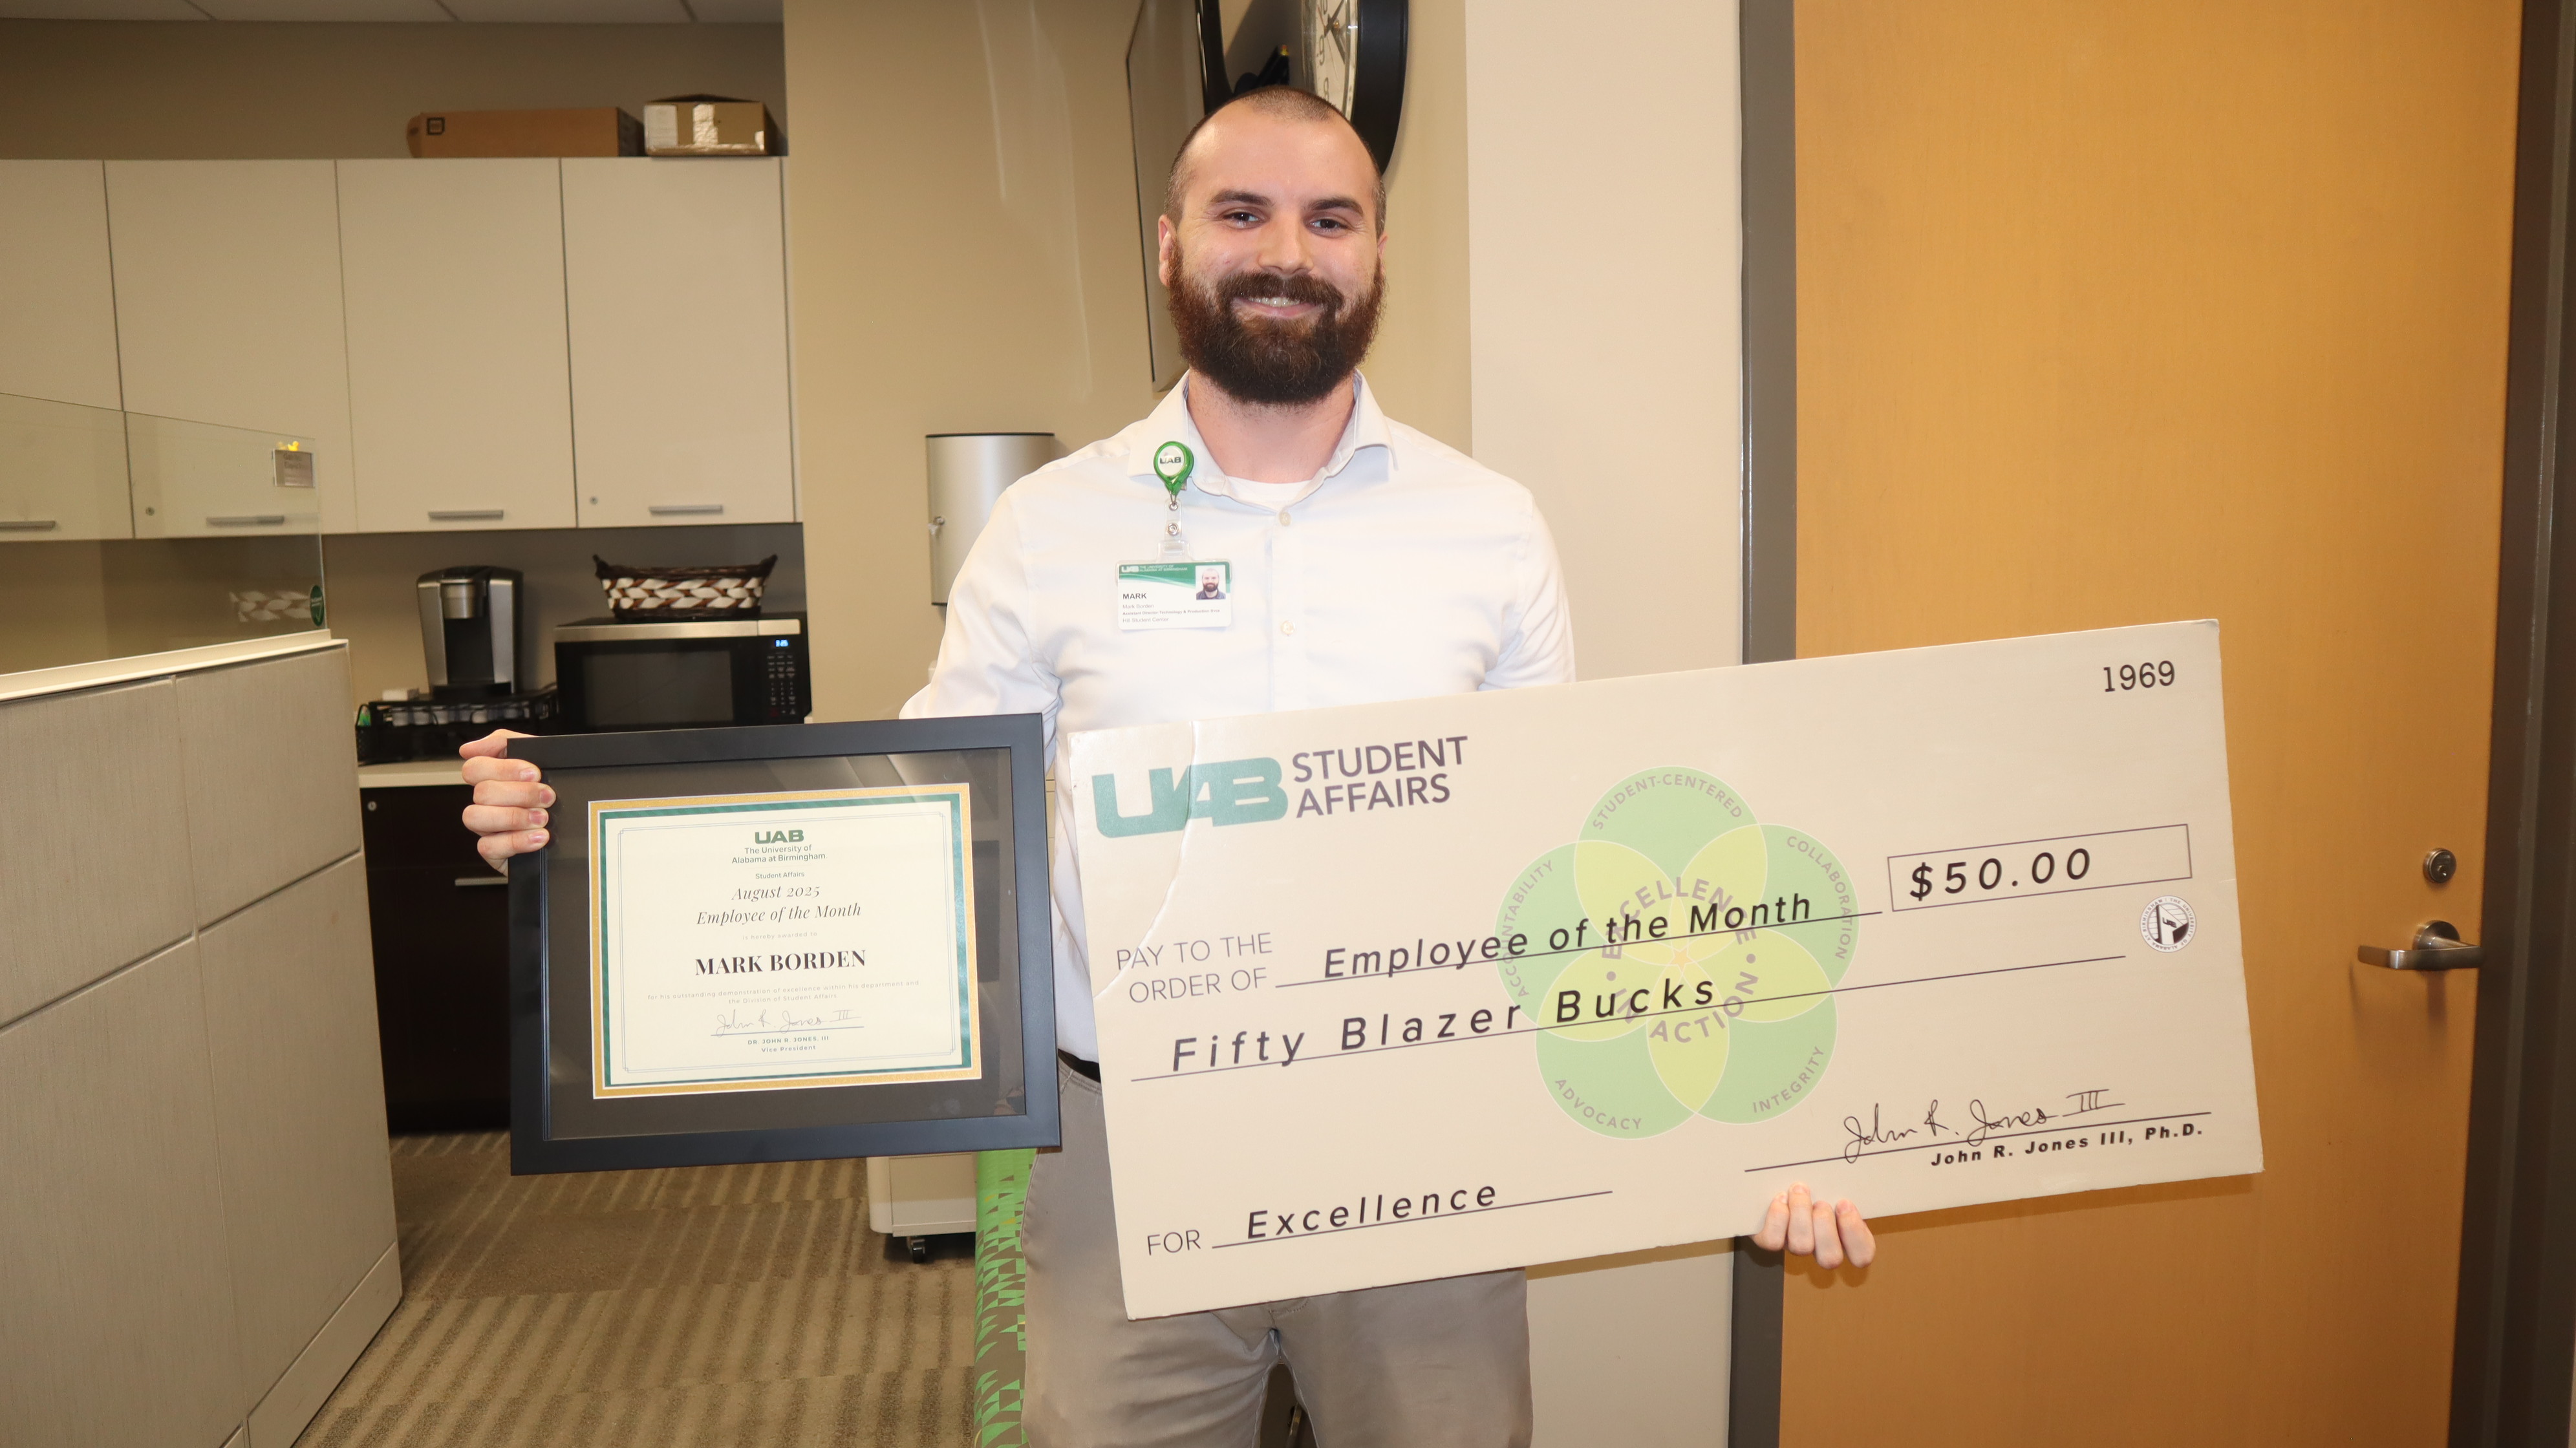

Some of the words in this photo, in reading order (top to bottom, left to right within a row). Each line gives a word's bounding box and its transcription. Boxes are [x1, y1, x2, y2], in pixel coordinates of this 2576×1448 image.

[2103, 660, 2175, 693] 1969
[1293, 736, 1468, 783] STUDENT
[1091, 757, 1288, 838] UAB
[1296, 773, 1450, 818] AFFAIRS
[1593, 773, 1743, 831] STUDENT-CENTERED
[755, 829, 804, 844] UAB
[762, 845, 802, 854] University
[731, 886, 782, 902] August
[786, 886, 821, 898] 2025
[1786, 835, 1852, 961] COLLABORATION
[1909, 847, 2092, 901] $50.00
[697, 909, 766, 926] Employee
[770, 906, 786, 923] of
[788, 906, 810, 920] the
[814, 902, 862, 919] Month
[1501, 860, 1554, 997] ACCOUNTABILITY
[695, 955, 763, 975] MARK
[769, 950, 866, 972] BORDEN
[1116, 944, 1164, 970] PAY
[1174, 940, 1210, 964] TO
[1219, 932, 1272, 958] THE
[1129, 974, 1221, 1003] ORDER
[1231, 967, 1267, 992] OF
[1324, 932, 1528, 978] Employee
[1549, 918, 1589, 952] of
[1606, 913, 1669, 944] the
[1690, 893, 1811, 933] Month
[1172, 1030, 1305, 1072] Fifty
[1340, 1000, 1521, 1051] Blazer
[1557, 978, 1713, 1023] Bucks
[1649, 971, 1759, 1043] ACTION
[1554, 1076, 1643, 1131] ADVOCACY
[1752, 1046, 1825, 1114] INTEGRITY
[1844, 1102, 1918, 1164] John
[1967, 1100, 2059, 1147] Jones
[1931, 1149, 1982, 1166] John
[1993, 1145, 2013, 1158] R.
[2025, 1138, 2089, 1155] Jones
[2100, 1131, 2134, 1145] III,
[2145, 1123, 2203, 1140] Ph.D.
[1146, 1229, 1202, 1256] FOR
[1247, 1185, 1499, 1240] Excellence
